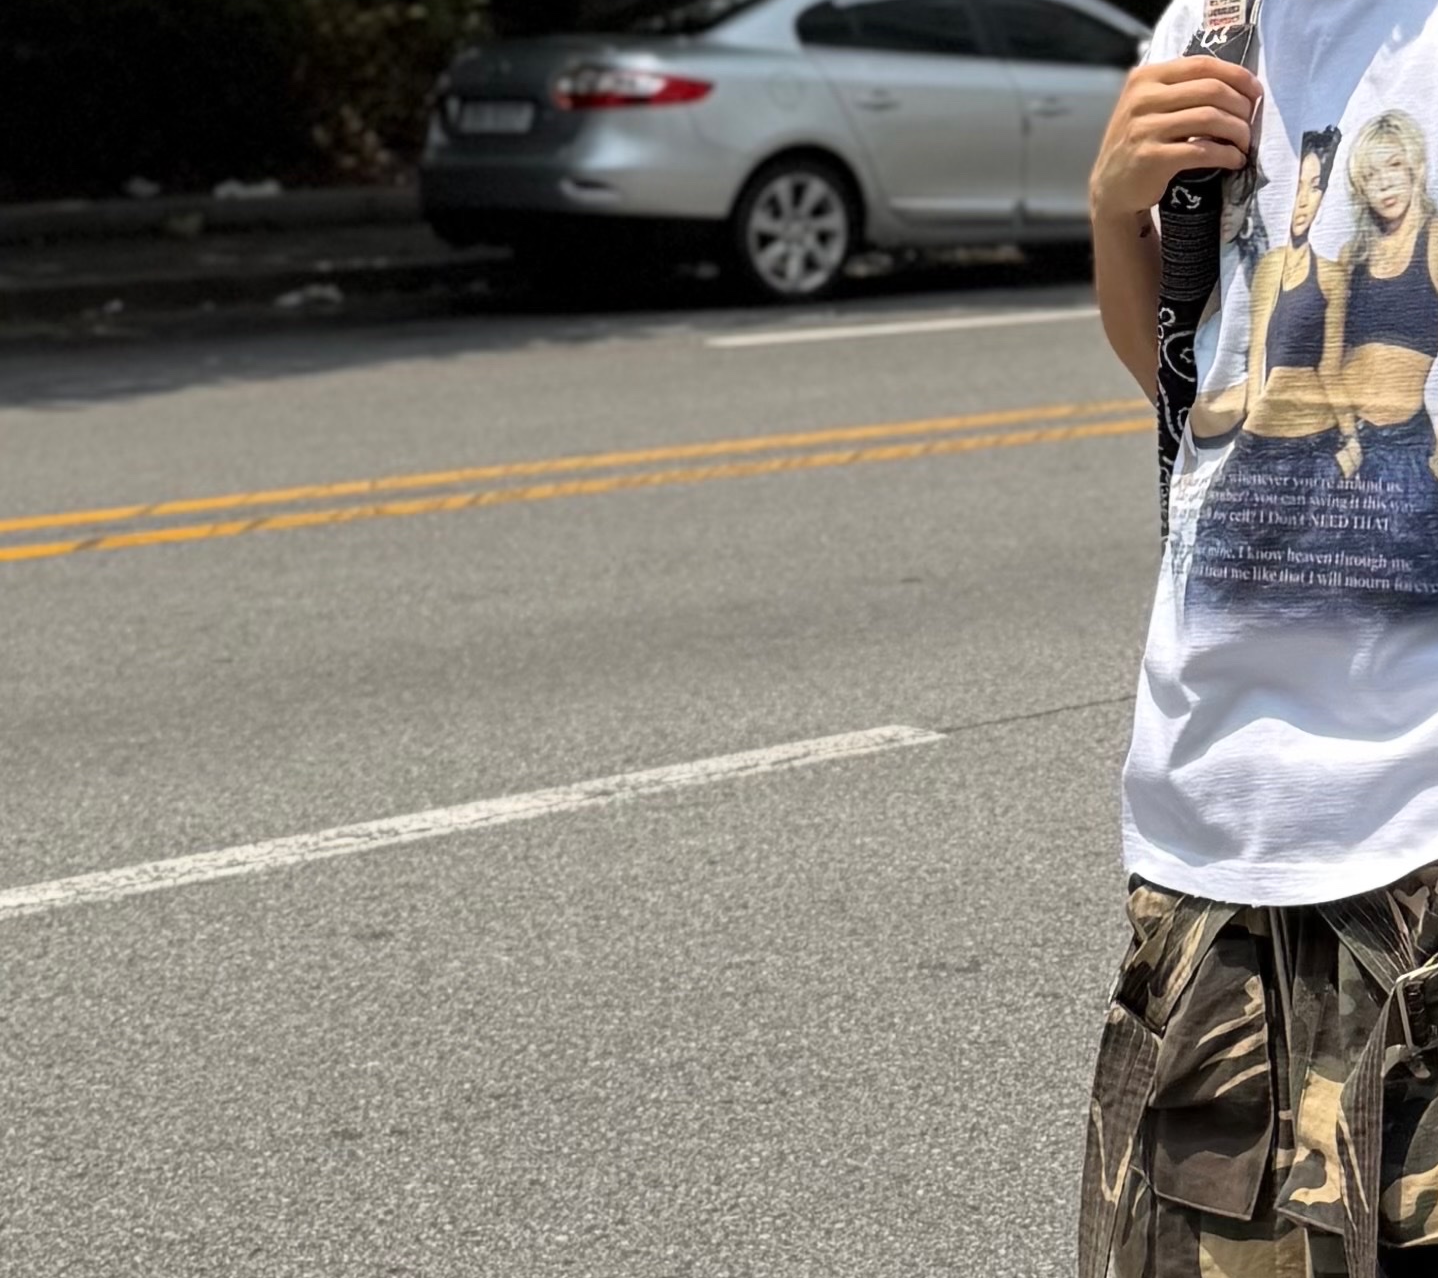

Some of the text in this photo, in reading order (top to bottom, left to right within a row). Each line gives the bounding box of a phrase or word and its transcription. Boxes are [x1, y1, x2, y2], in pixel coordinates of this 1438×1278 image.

[1227, 471, 1290, 486] whenever
[1254, 492, 1277, 507] you
[1280, 494, 1305, 507] can
[1309, 513, 1350, 528] NEED
[1353, 514, 1389, 531] THAT
[1246, 545, 1284, 561] know
[1287, 547, 1332, 565] heaven
[1334, 550, 1388, 572] through
[1252, 566, 1277, 582] like
[1279, 568, 1306, 584] that
[1316, 570, 1342, 586] will
[1344, 575, 1391, 589] mourn
